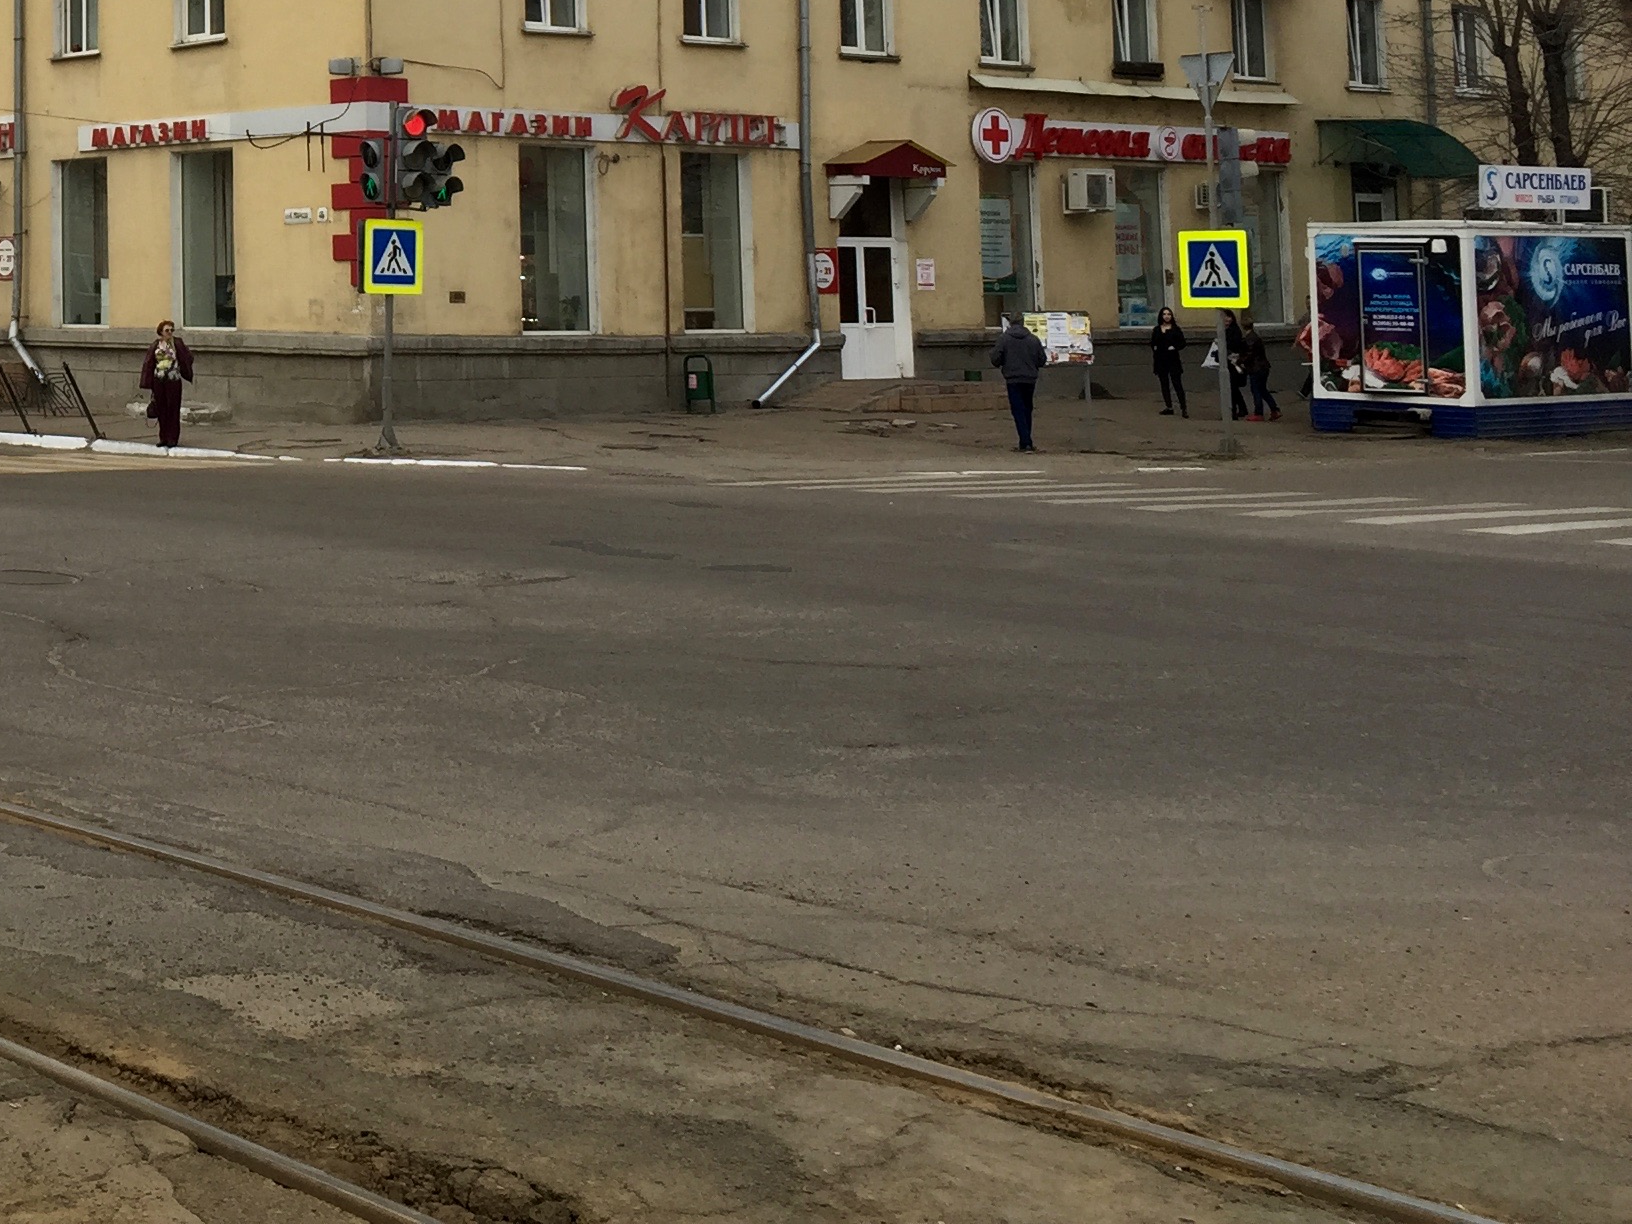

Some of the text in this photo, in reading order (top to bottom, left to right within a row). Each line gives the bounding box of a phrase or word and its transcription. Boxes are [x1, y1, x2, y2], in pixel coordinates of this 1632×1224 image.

[91, 119, 206, 147] МАГАЗИН
[437, 109, 592, 137] МАГАЗИН
[1013, 113, 1292, 164] Детская апека
[1505, 172, 1586, 190] САРСЕНБАЕВ
[1537, 194, 1555, 204] РЫБА
[1564, 263, 1620, 276] САРСЕНБАЕВ
